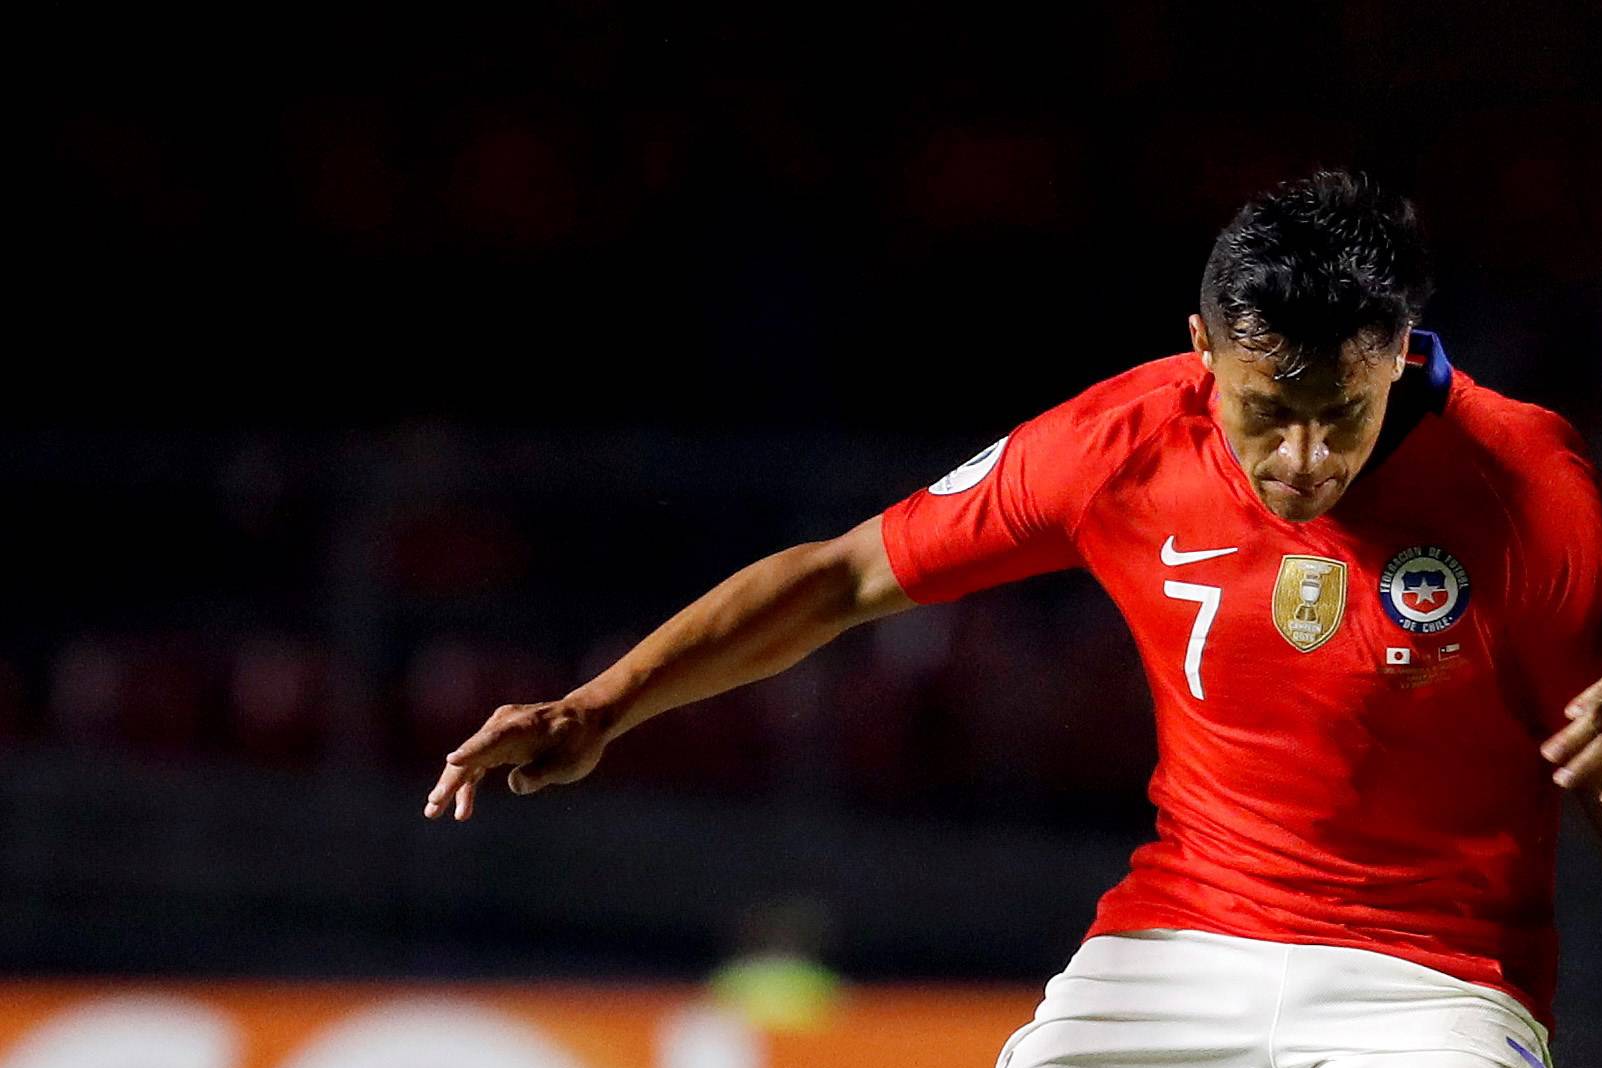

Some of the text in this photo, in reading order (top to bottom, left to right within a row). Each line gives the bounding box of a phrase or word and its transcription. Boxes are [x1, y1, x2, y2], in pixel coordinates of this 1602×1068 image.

[1163, 580, 1222, 700] 7
[1403, 617, 1450, 632] DE CHILE
